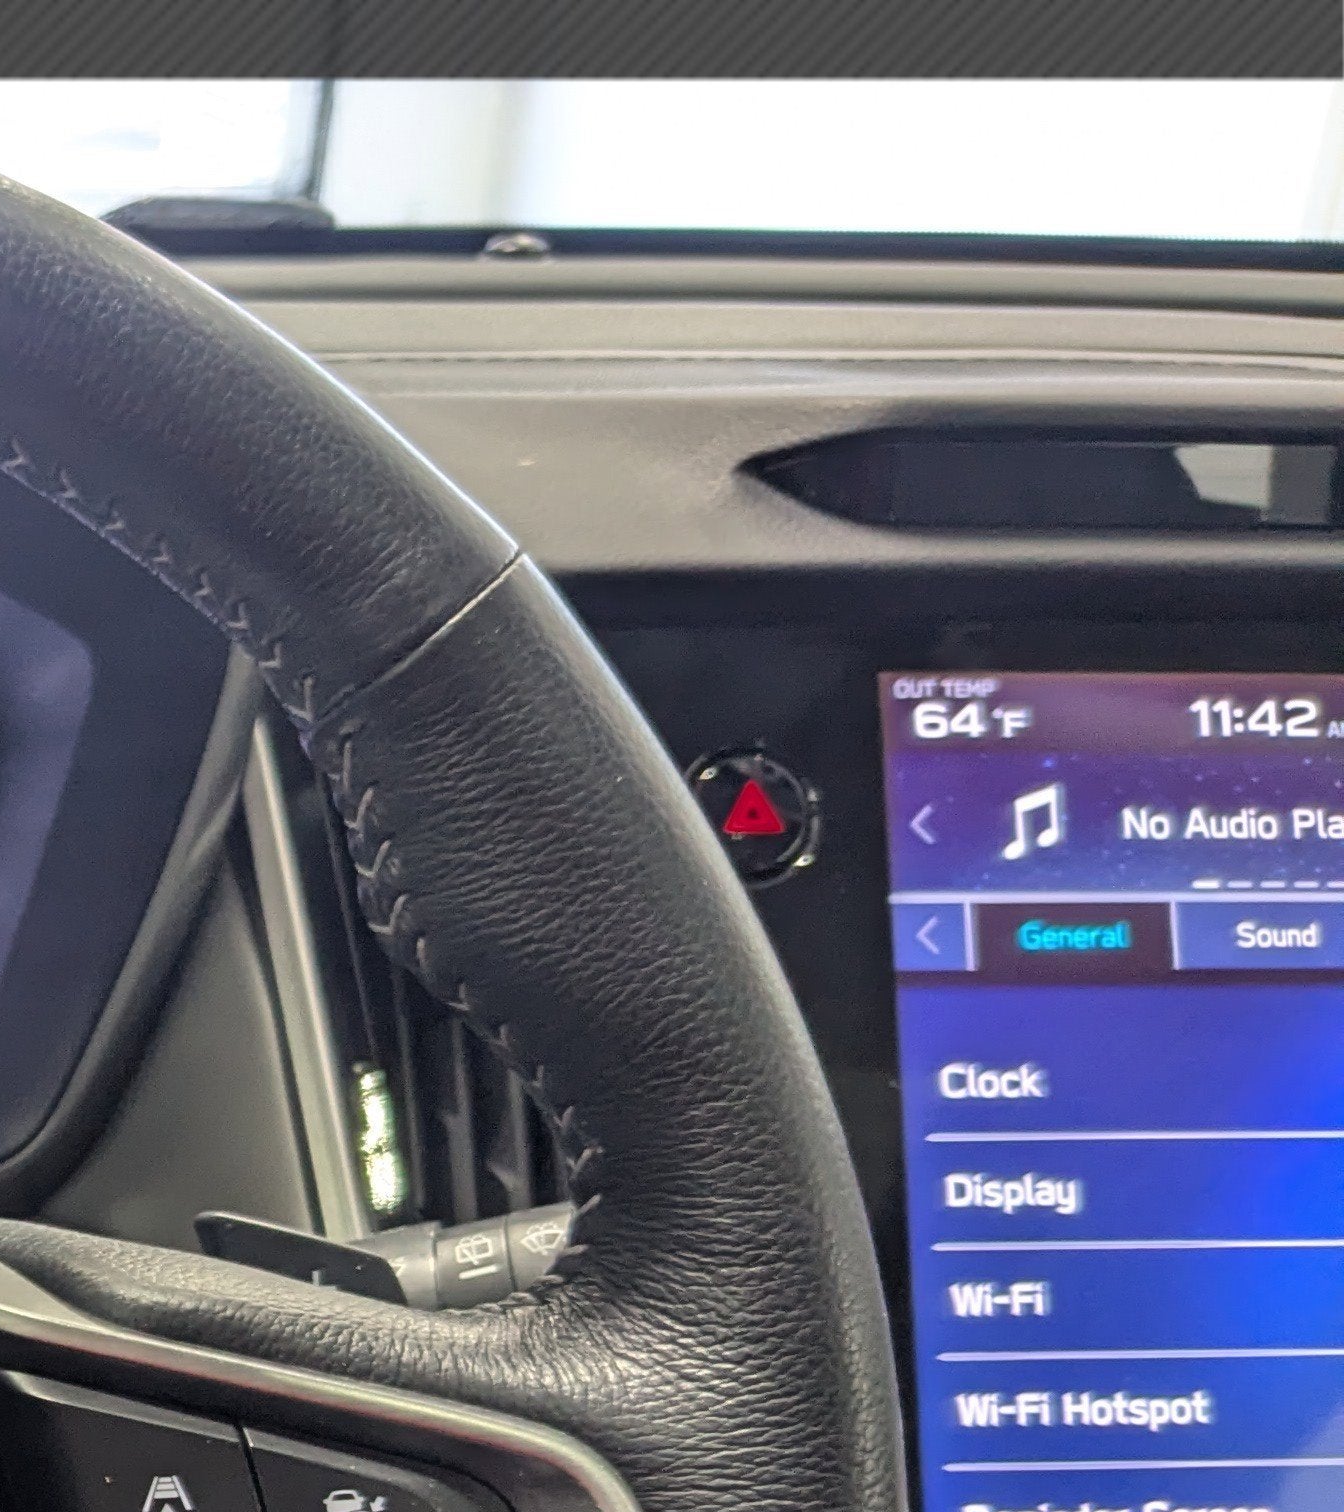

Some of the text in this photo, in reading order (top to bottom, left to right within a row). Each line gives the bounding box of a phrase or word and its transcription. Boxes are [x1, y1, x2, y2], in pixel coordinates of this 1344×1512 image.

[892, 680, 1000, 699] OUT TEMP
[913, 703, 985, 738] 64
[1189, 699, 1319, 738] 11:42
[1121, 808, 1170, 840] No
[1185, 807, 1278, 840] Audio
[1018, 920, 1132, 951] General
[1236, 922, 1321, 949] Sound
[939, 1063, 1049, 1098] Clock
[944, 1172, 1082, 1214] Display
[949, 1282, 1051, 1317] Wi-Fi
[954, 1390, 1211, 1431] Wi-Fi Hotspot
